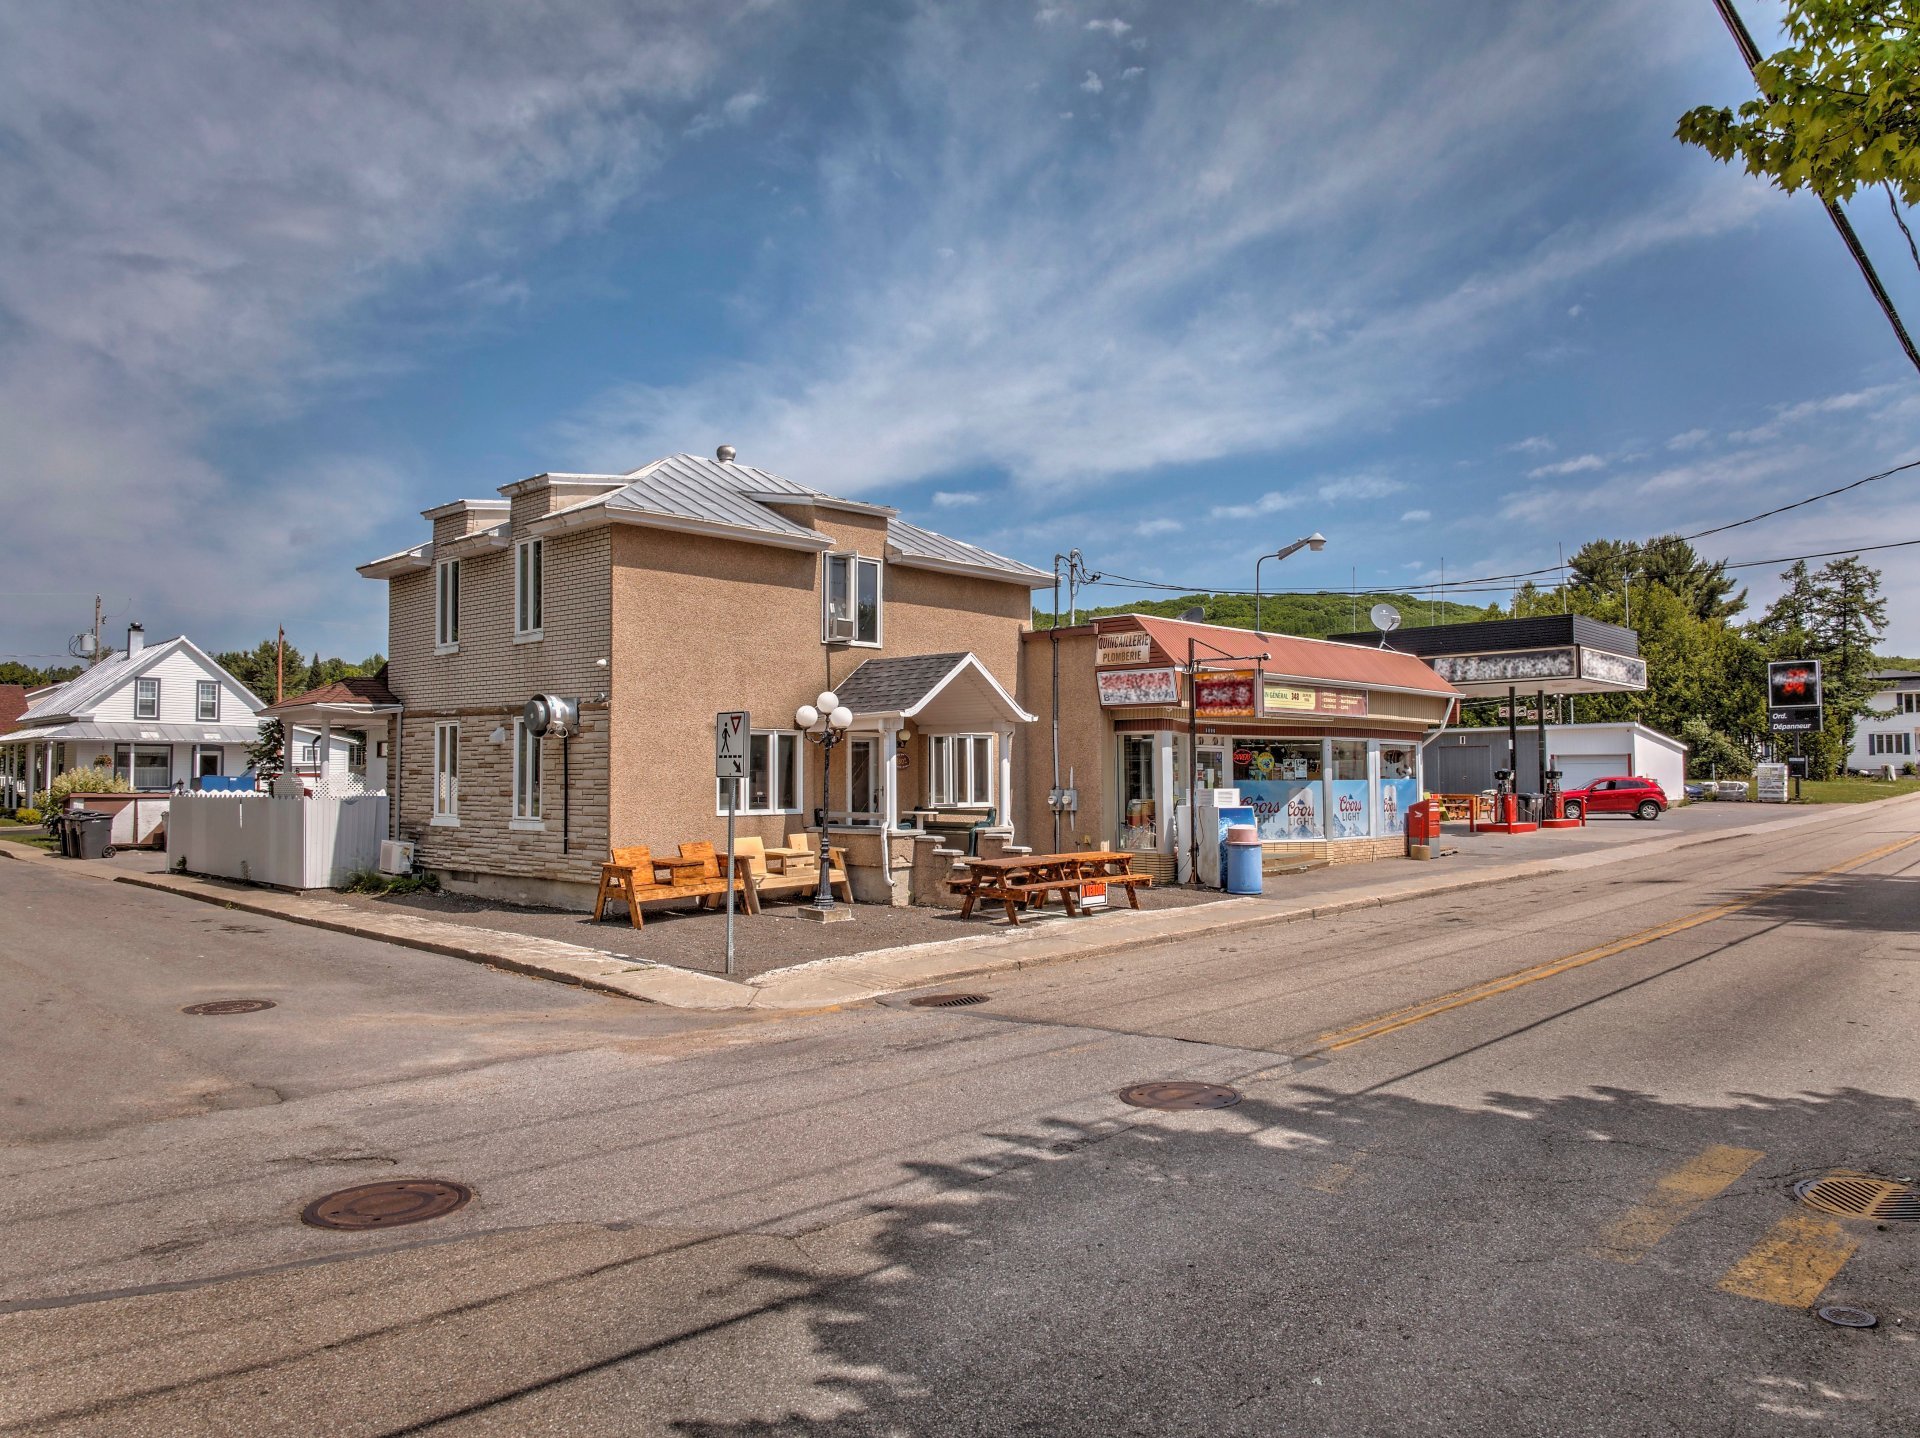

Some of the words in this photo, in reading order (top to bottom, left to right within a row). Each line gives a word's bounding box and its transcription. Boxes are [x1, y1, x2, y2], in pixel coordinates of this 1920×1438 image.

[1098, 634, 1149, 650] QUINCAILLERIE
[1103, 650, 1142, 662] PLOMBERIE
[1772, 712, 1788, 720] Ord.
[1773, 723, 1812, 731] Dépanneur
[1240, 797, 1280, 813] Coors
[1340, 796, 1362, 812] Coors
[1342, 812, 1360, 821] LIGHT
